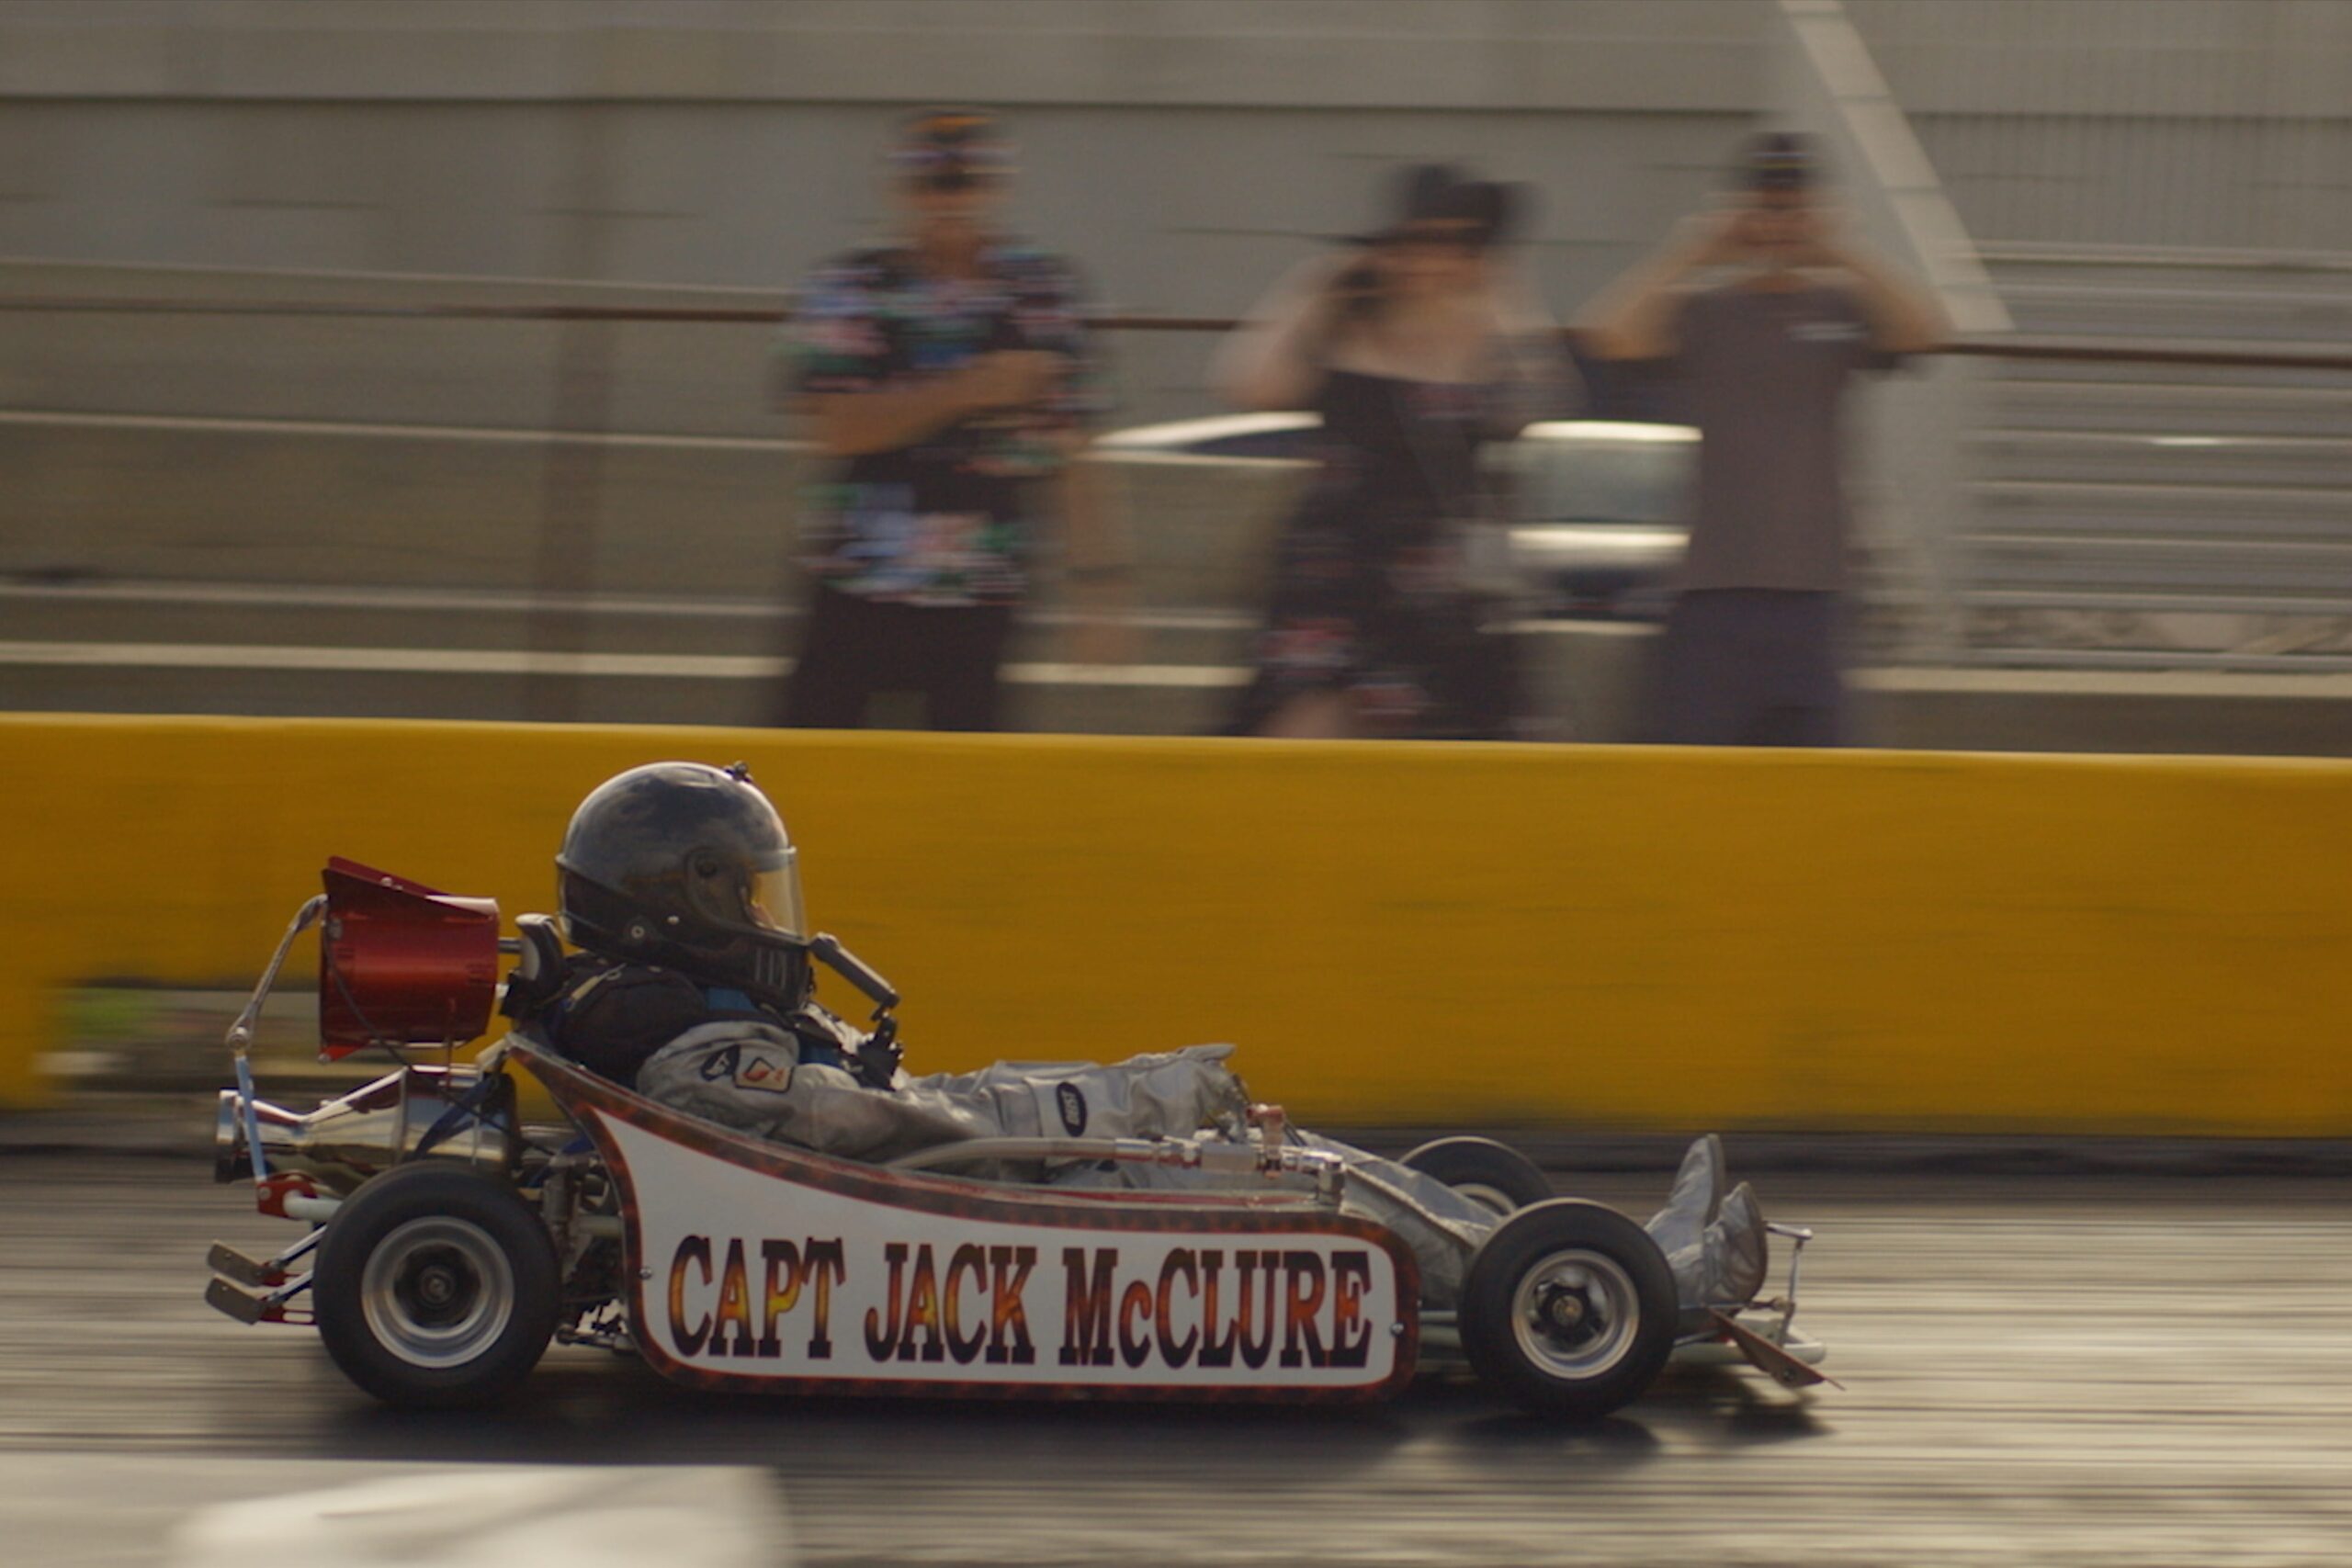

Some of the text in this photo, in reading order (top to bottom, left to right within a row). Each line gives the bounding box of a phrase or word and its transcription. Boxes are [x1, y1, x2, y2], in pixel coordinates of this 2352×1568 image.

[669, 1235, 1372, 1369] CAPT JACK McCLURE
